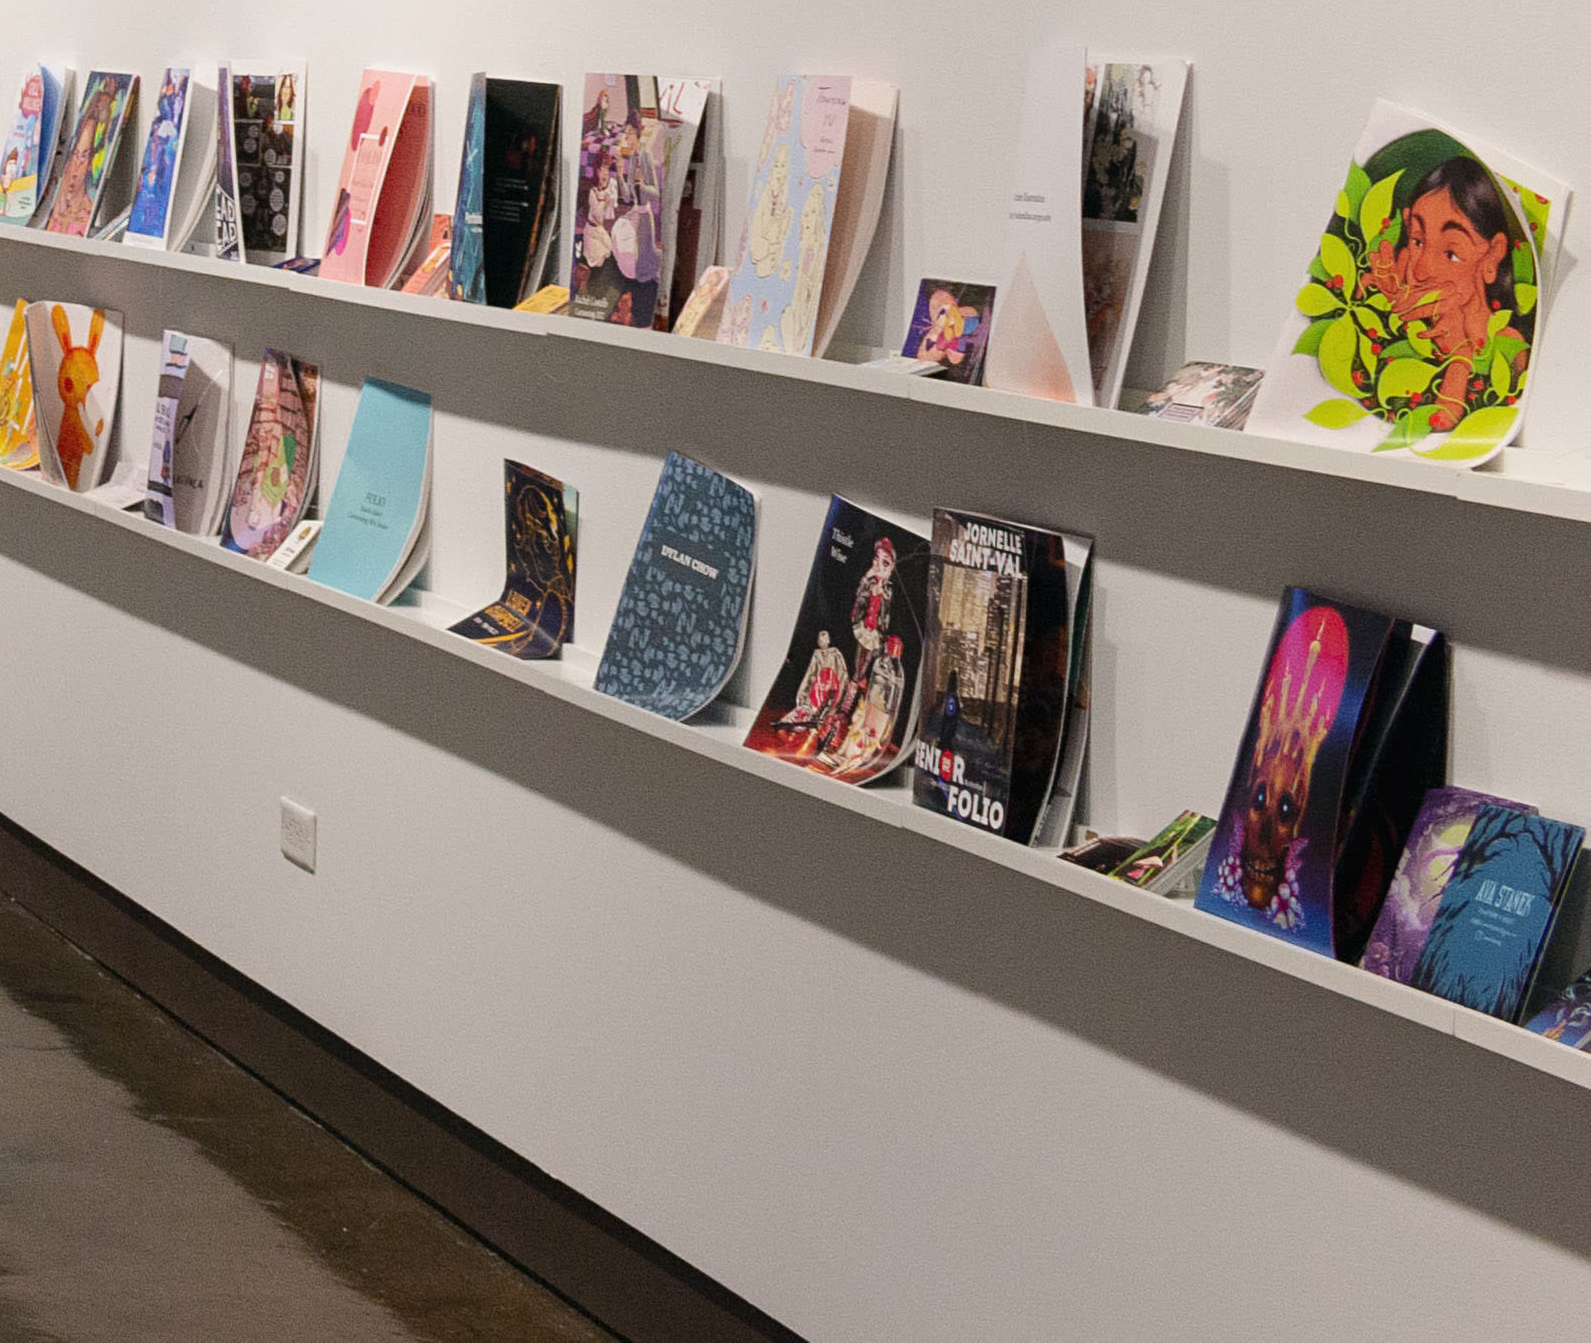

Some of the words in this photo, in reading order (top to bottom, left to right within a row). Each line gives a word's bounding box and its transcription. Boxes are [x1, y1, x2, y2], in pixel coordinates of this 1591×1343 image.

[964, 521, 1023, 555] JORNELLE
[661, 544, 692, 567] DYLAN
[690, 558, 719, 579] CHOW
[949, 538, 1028, 580] SAINT-VAL
[947, 785, 1004, 829] FOLIO
